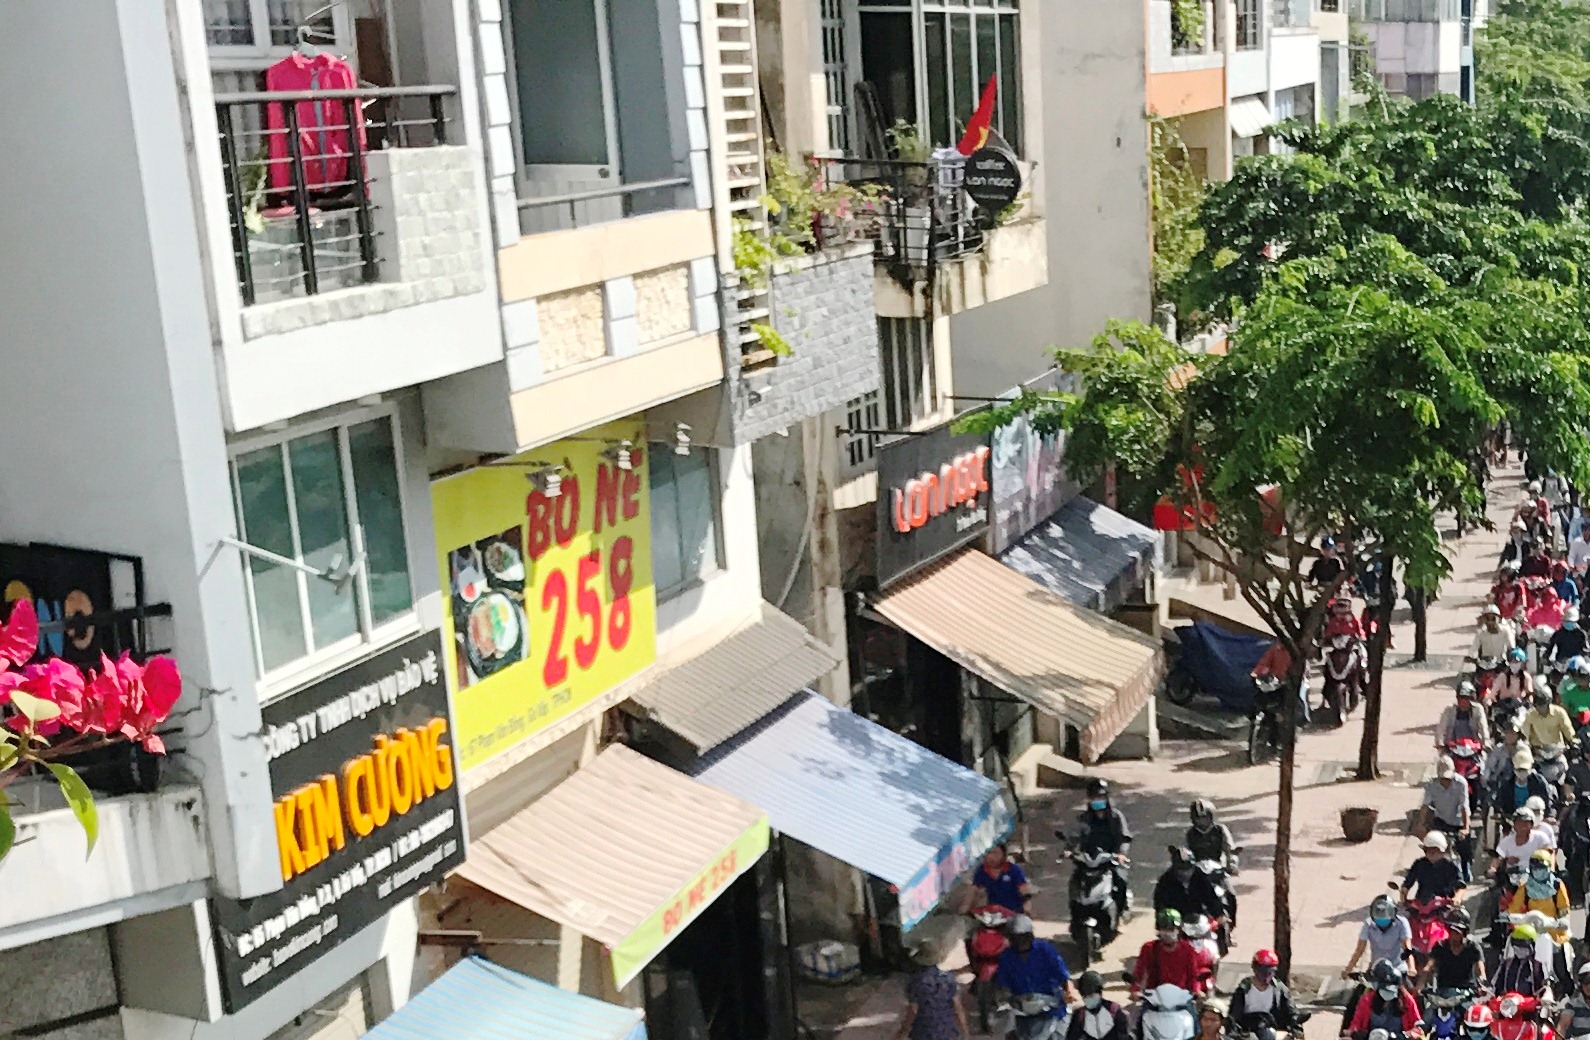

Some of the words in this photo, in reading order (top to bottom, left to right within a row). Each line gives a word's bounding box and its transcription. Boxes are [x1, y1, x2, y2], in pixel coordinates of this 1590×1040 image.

[542, 536, 634, 689] 258
[274, 774, 345, 883] KIM
[345, 716, 454, 836] CƯƠNG
